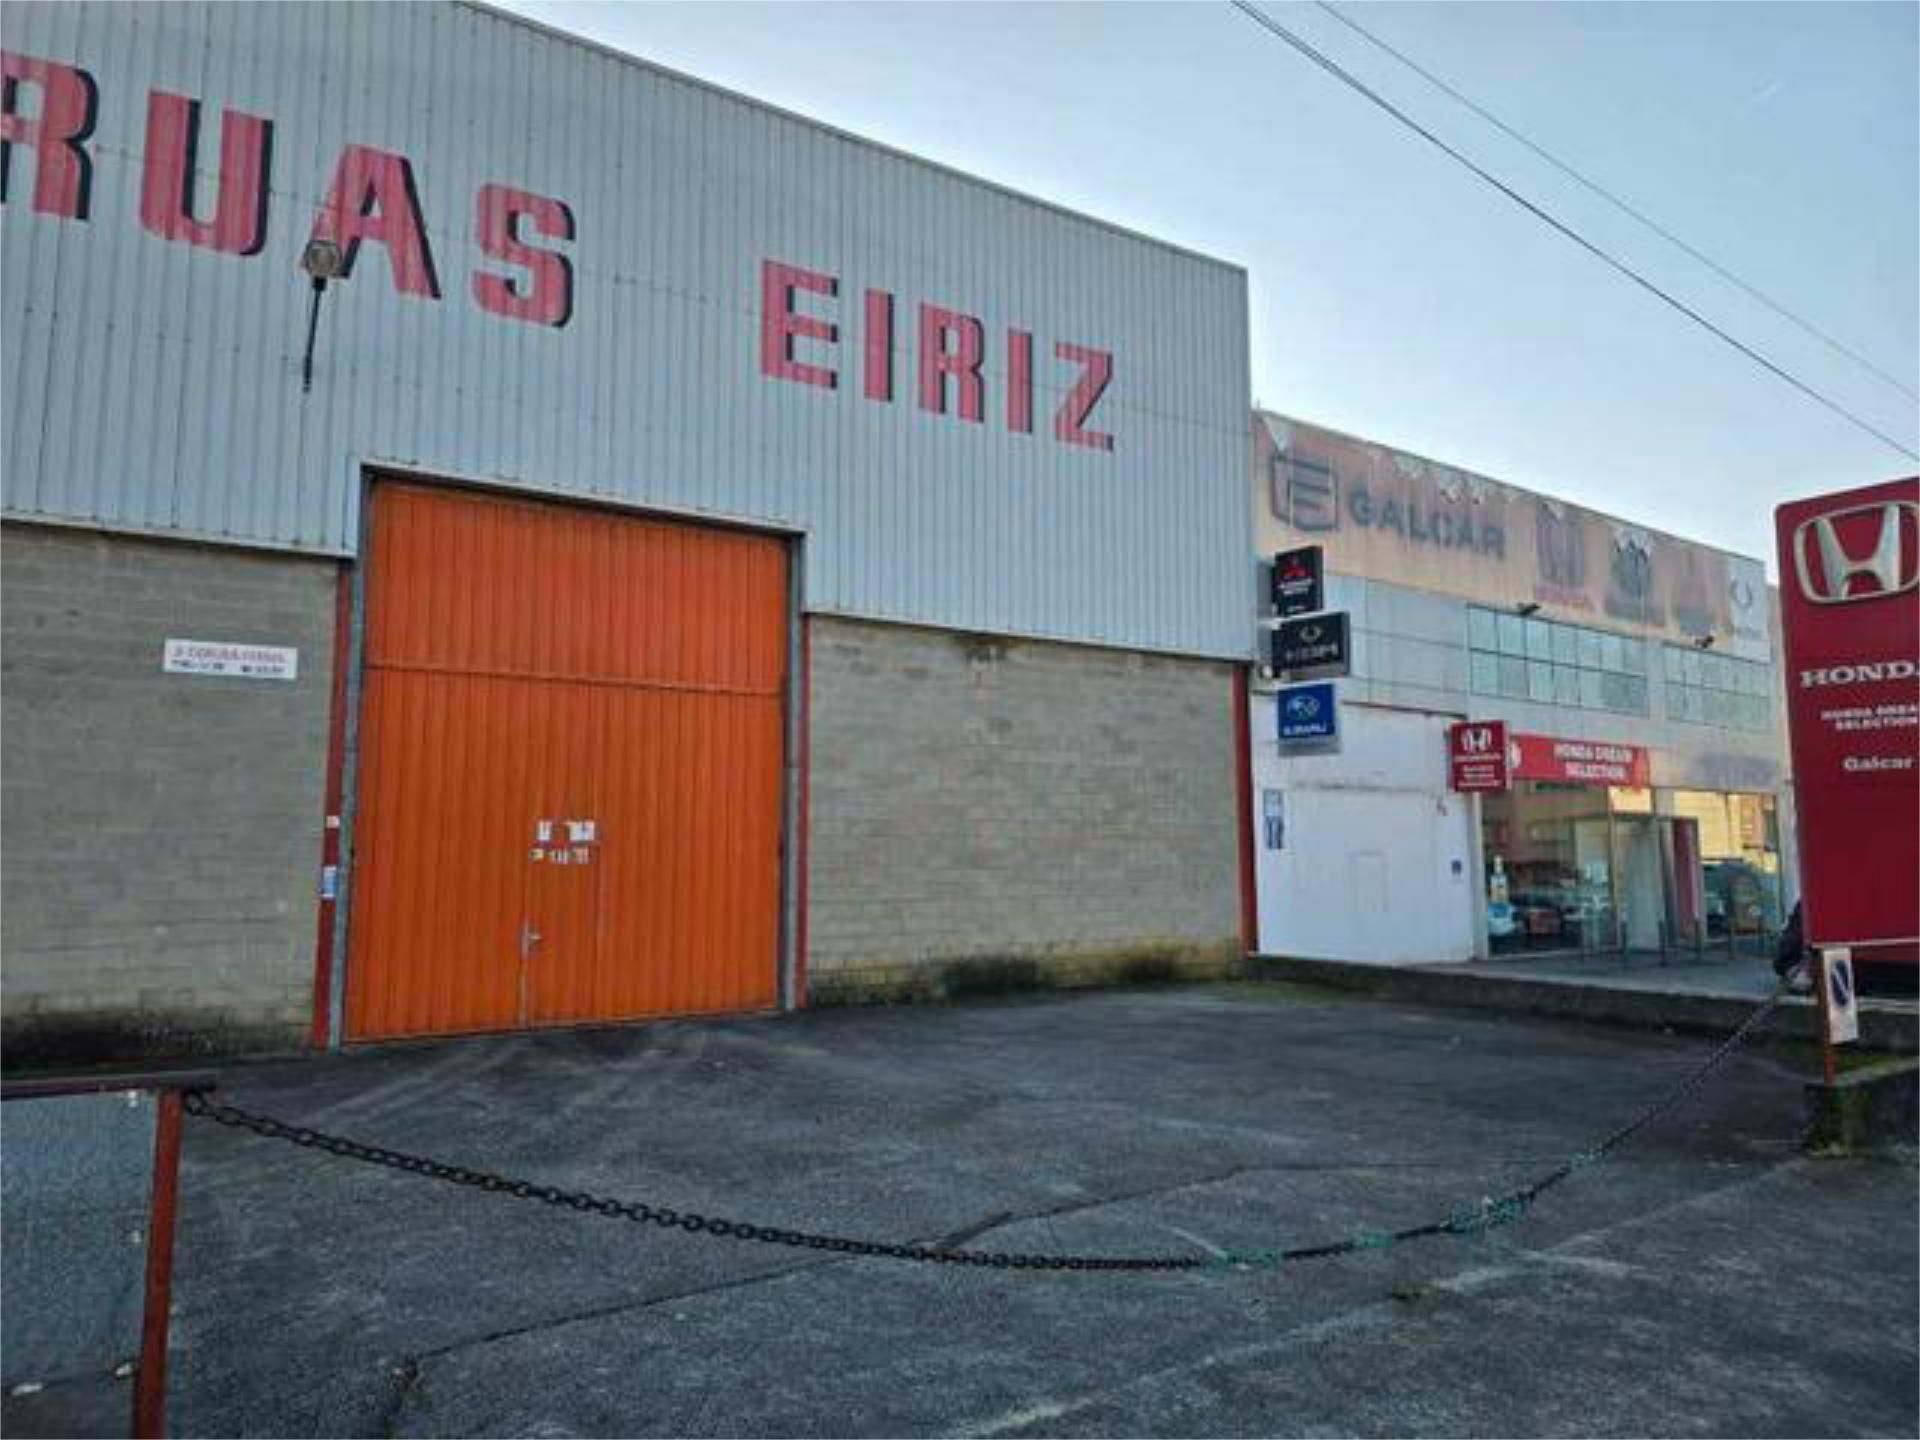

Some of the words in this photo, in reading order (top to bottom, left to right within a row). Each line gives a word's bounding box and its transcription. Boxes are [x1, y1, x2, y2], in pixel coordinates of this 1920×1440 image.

[761, 258, 1114, 451] EIRIZ
[1349, 484, 1506, 561] GALCAR
[1800, 660, 1918, 687] HOND
[1843, 755, 1913, 772] Galcar
